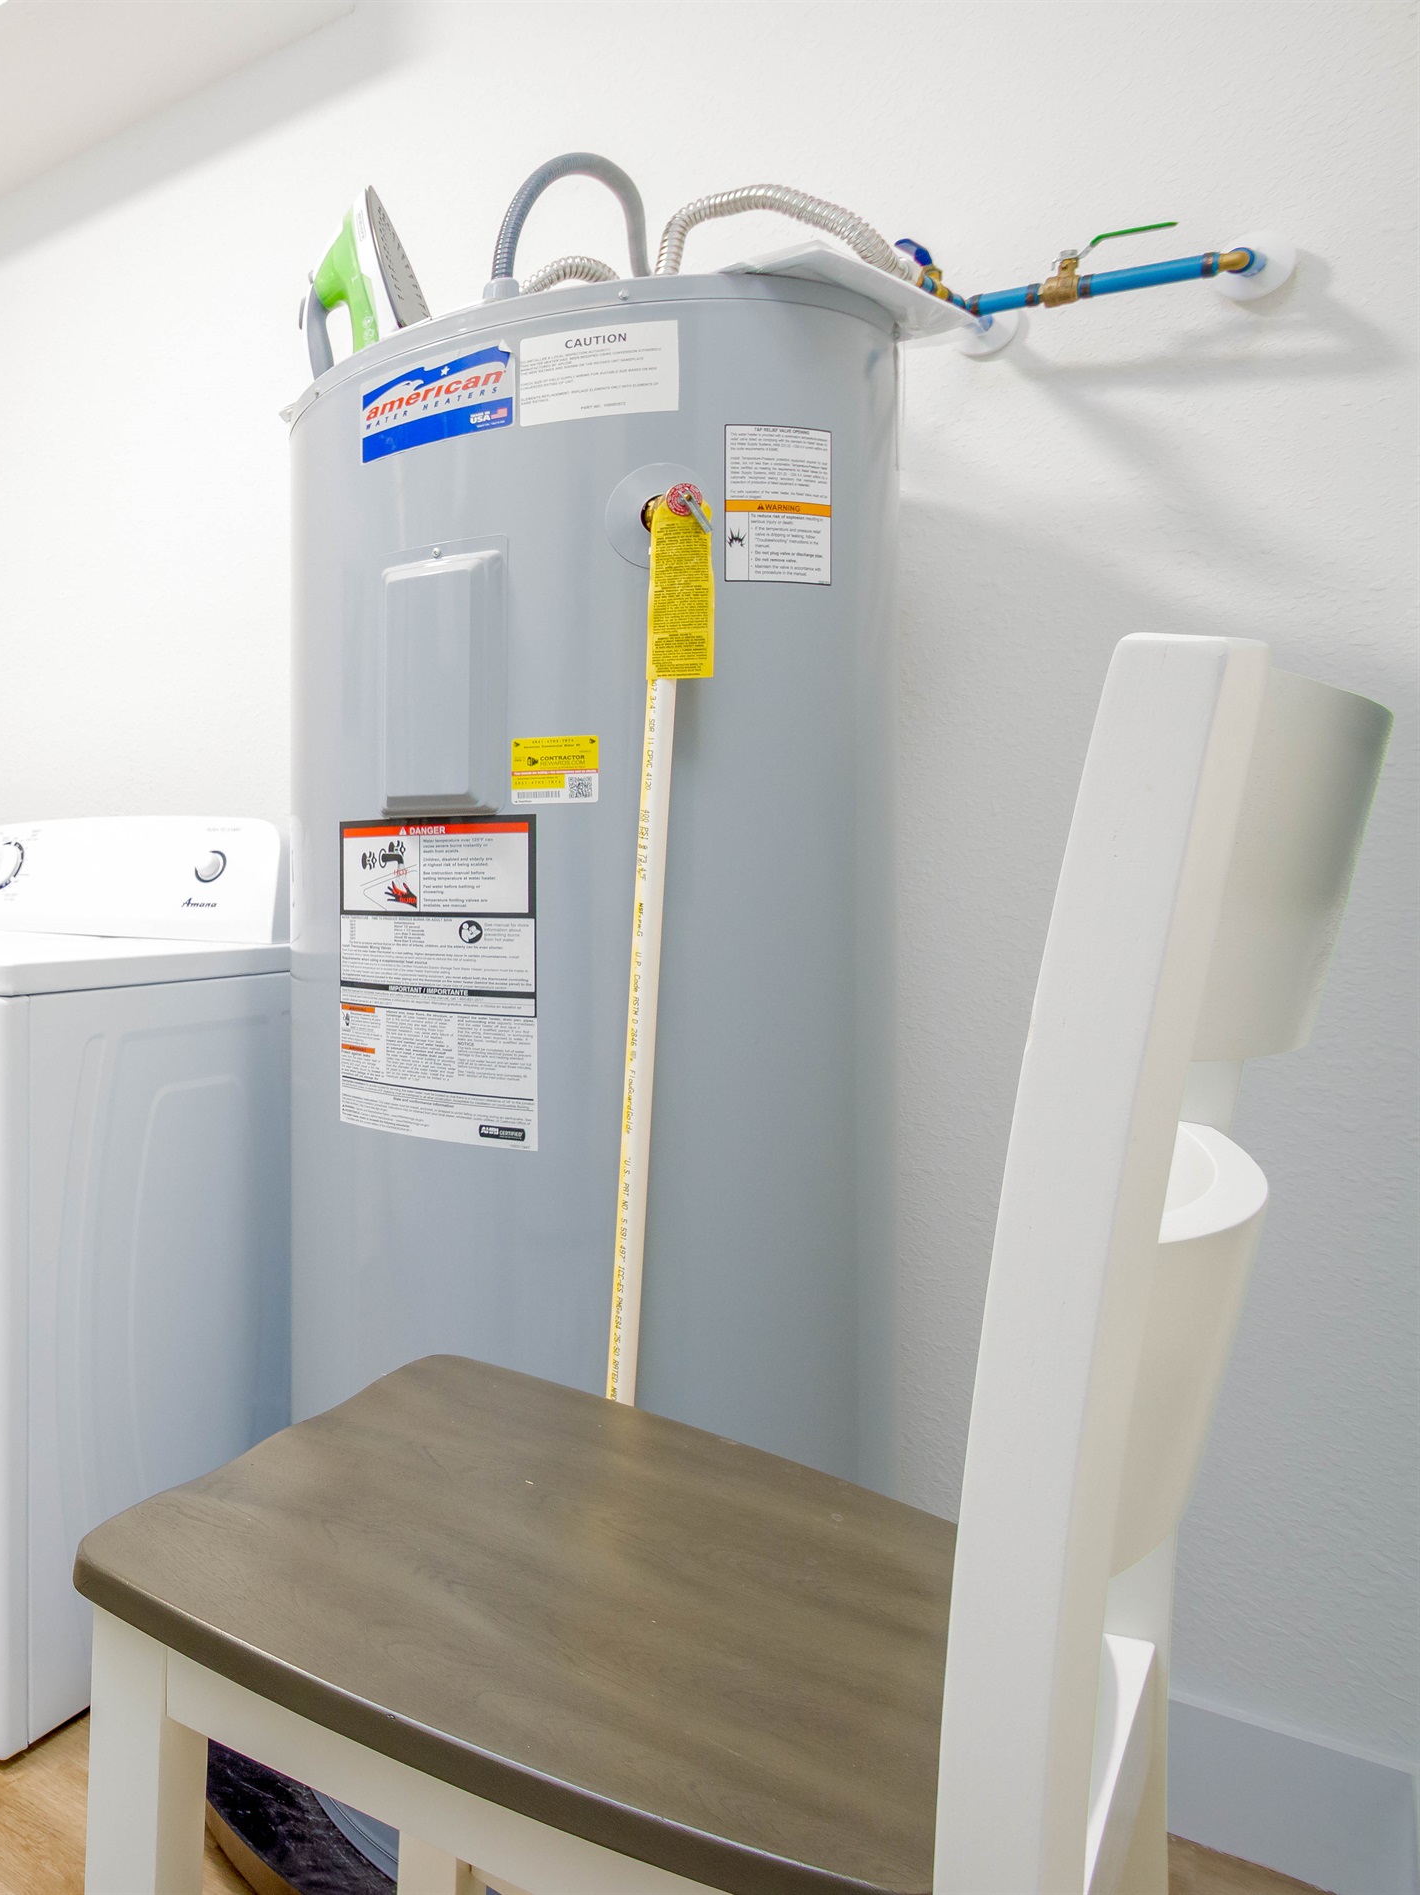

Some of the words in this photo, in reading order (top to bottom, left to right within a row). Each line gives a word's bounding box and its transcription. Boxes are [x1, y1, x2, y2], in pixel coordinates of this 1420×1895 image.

[565, 333, 627, 348] CAUTION
[366, 370, 503, 421] american
[366, 410, 408, 430] WATER
[423, 386, 497, 410] HEATERS
[470, 415, 490, 424] USA
[409, 826, 446, 835] DANGER
[181, 898, 217, 908] Amana
[389, 985, 422, 993] IMPORTANT
[427, 988, 468, 996] IMPORTANTE
[616, 1265, 625, 1293] ICC-ES
[611, 1358, 619, 1383] RATED
